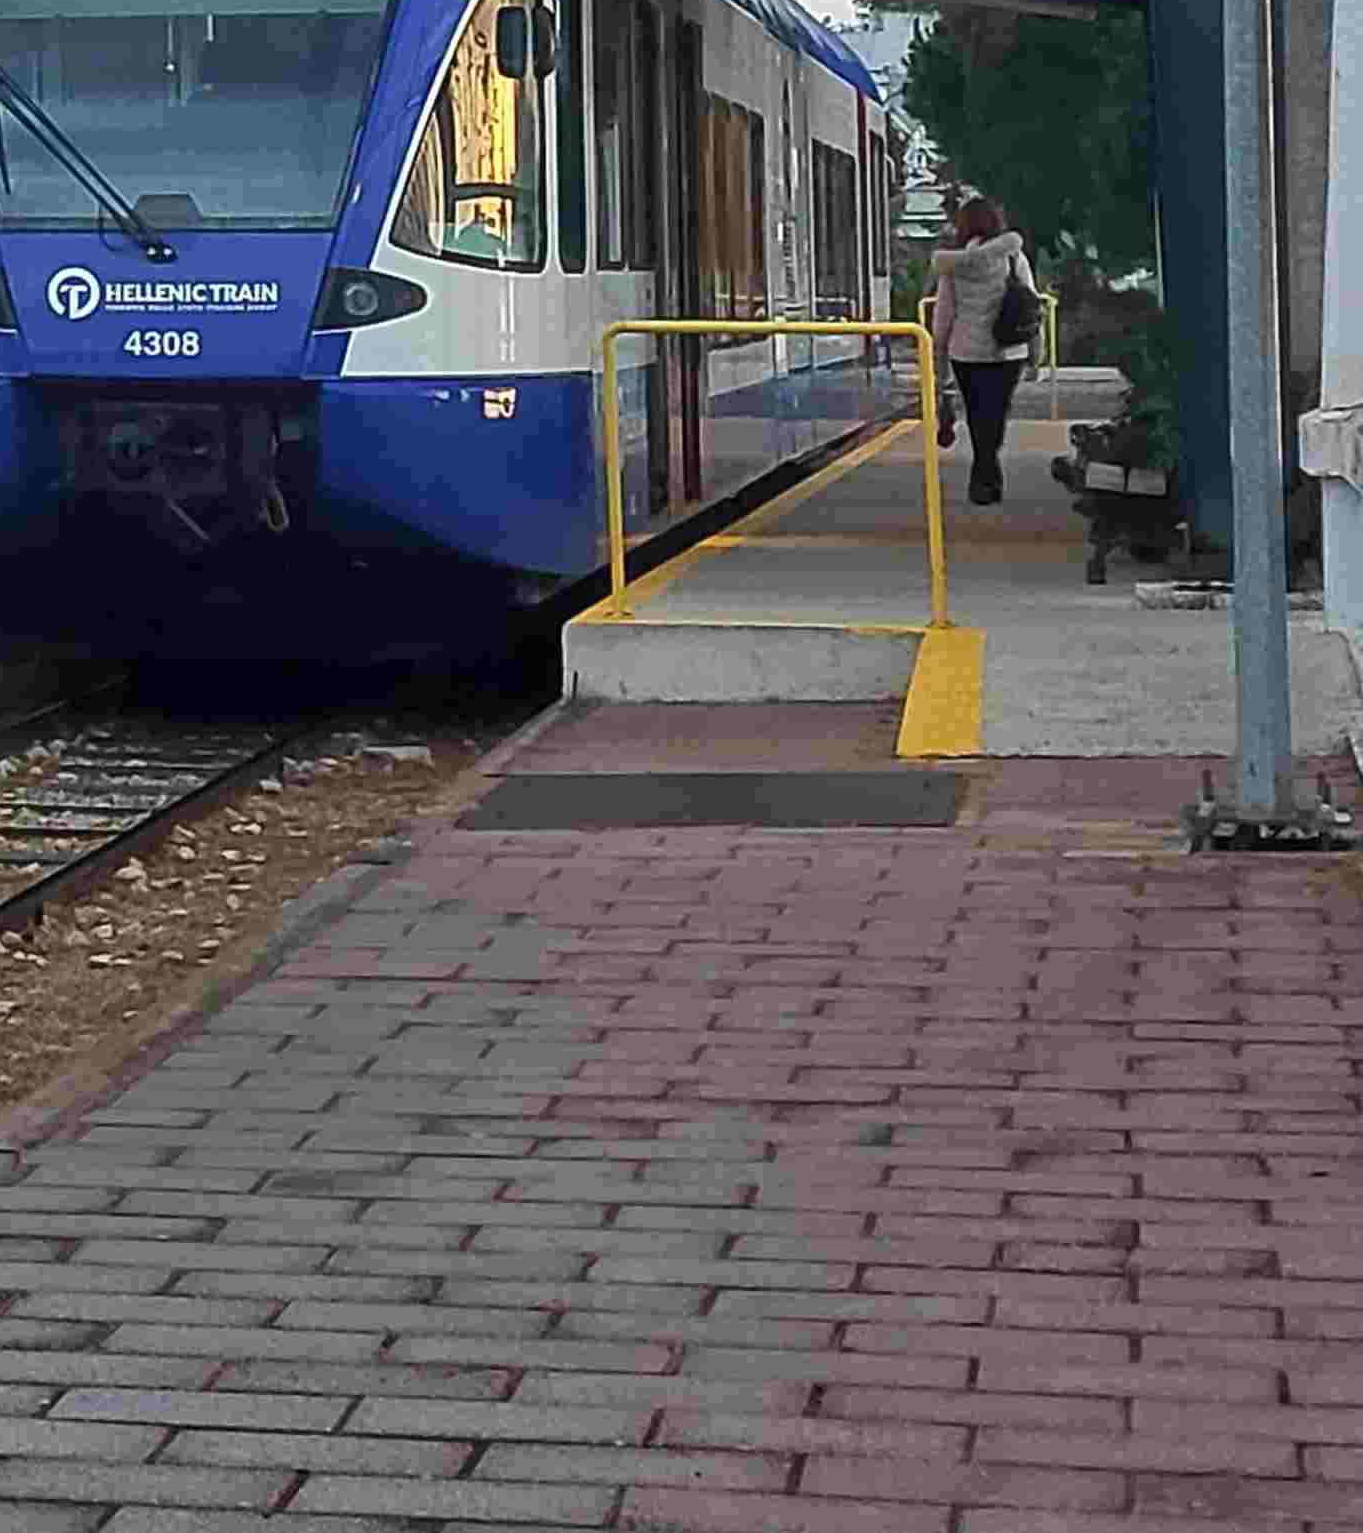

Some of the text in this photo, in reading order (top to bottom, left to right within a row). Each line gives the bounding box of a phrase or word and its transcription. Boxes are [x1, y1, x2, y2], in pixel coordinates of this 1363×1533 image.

[105, 282, 278, 303] HELLENIC TRAIN
[123, 330, 200, 356] 4308
